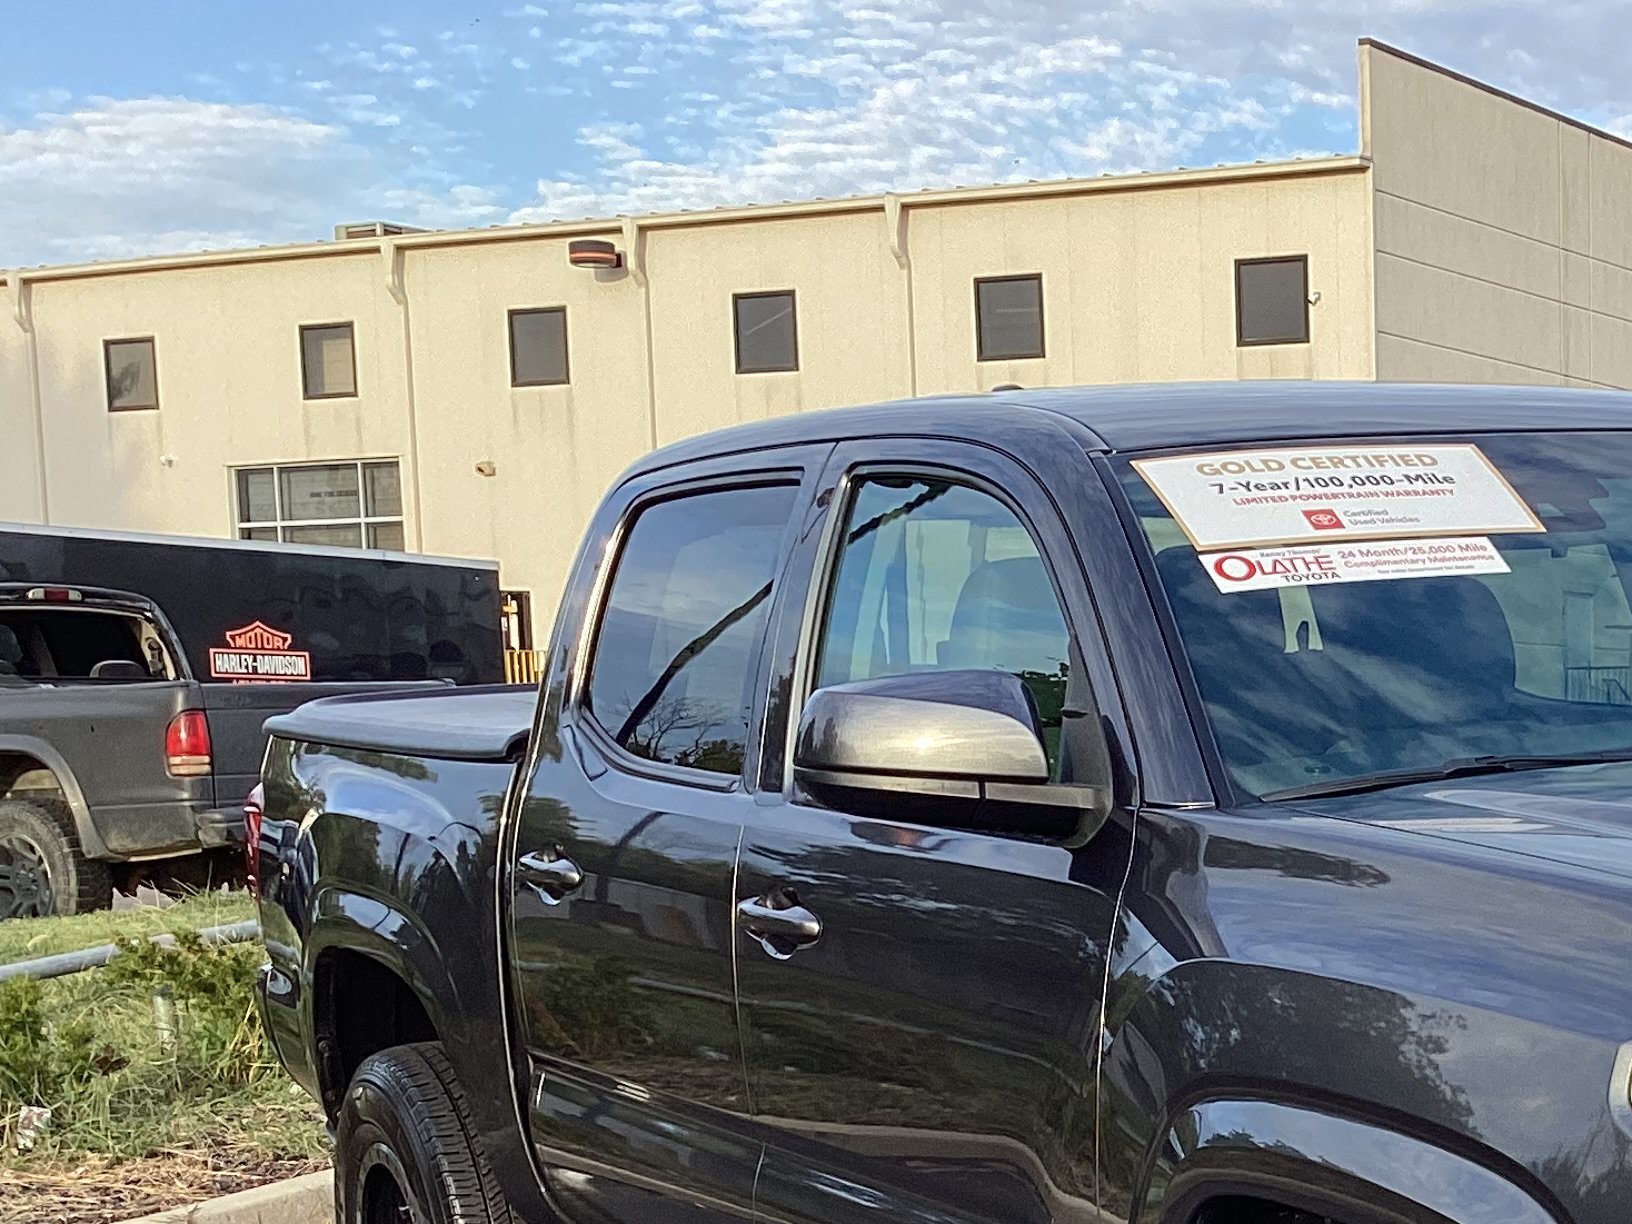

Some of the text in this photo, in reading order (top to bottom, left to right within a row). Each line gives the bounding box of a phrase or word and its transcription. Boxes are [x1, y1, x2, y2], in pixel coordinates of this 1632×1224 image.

[1196, 454, 1438, 476] GOLD CERTIFIED
[1233, 489, 1454, 505] LIMITED POWERTRAIN WARRANTY
[1343, 509, 1389, 517] Certified
[1337, 551, 1356, 559] 24
[1344, 557, 1427, 569] Complimentary
[1213, 554, 1337, 582] OLATHE
[1282, 572, 1341, 582] TOYOTA
[235, 627, 283, 649] MOTOR
[214, 653, 306, 676] HARLEY-DAVIDSON
